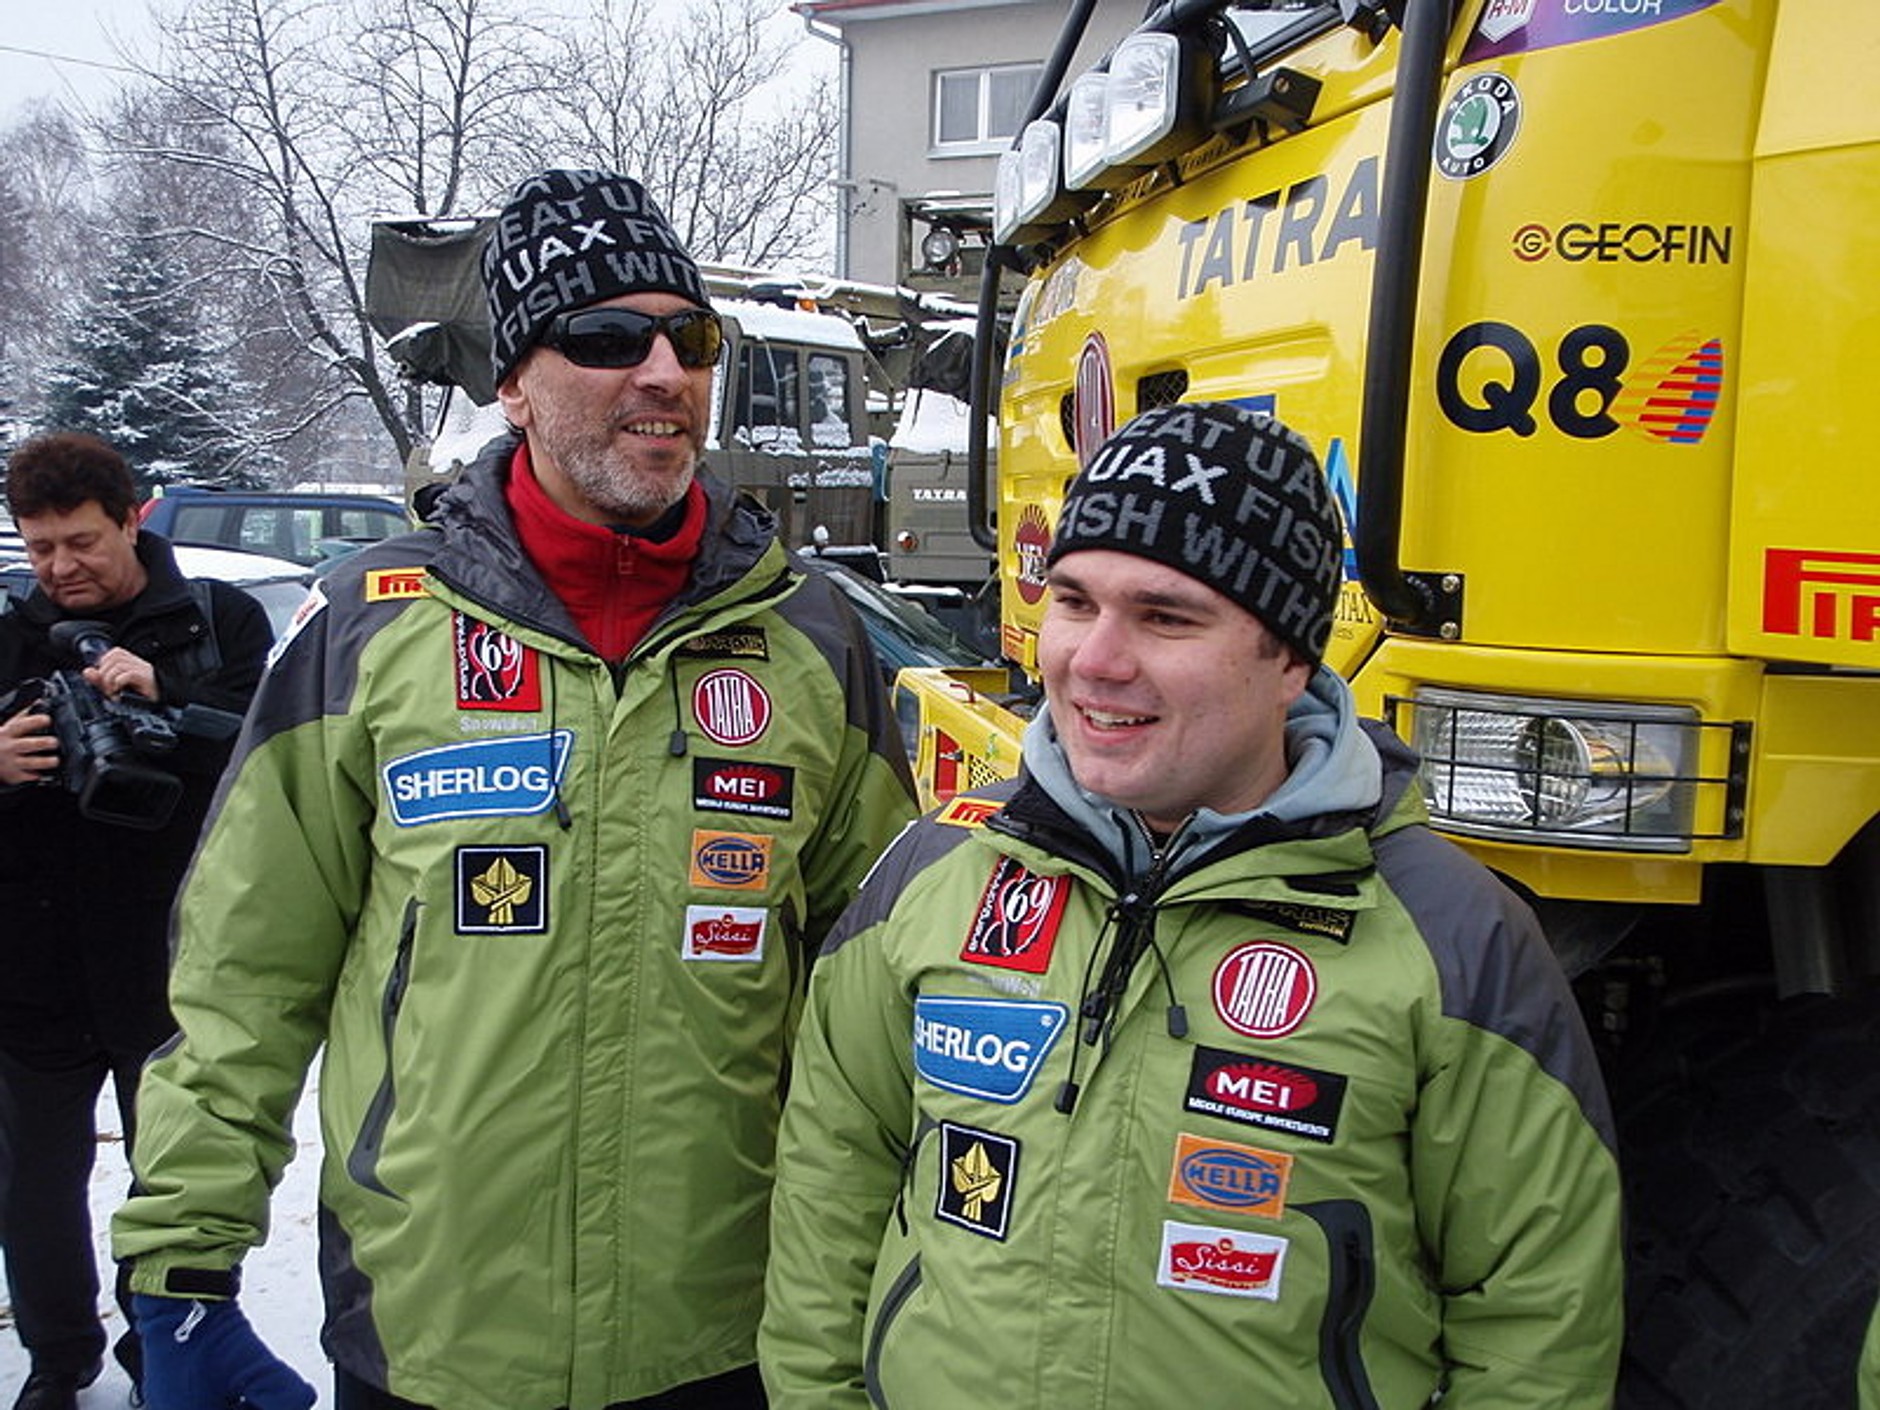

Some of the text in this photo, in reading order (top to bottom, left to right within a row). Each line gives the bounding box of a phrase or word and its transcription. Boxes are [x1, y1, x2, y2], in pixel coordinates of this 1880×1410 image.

[1441, 157, 1485, 173] AUTO
[500, 196, 584, 250] EAT
[1178, 155, 1379, 300] TATRA
[1556, 223, 1732, 264] GEOFIN
[502, 219, 616, 291] UAX
[502, 261, 597, 354] FISH
[1436, 321, 1630, 439] Q8
[1120, 406, 1235, 450] EAT
[1088, 444, 1341, 594] UAX FISH
[481, 630, 518, 671] 69
[705, 677, 755, 738] TATRA
[396, 766, 549, 800] SHERLOG
[714, 775, 765, 798] MEI
[702, 852, 765, 873] HELLA
[1006, 878, 1050, 924] 69
[1228, 952, 1299, 1028] TATRA
[1216, 1071, 1291, 1109] MEI
[1187, 1163, 1280, 1195] HELLA
[1176, 1245, 1260, 1275] Sissi
